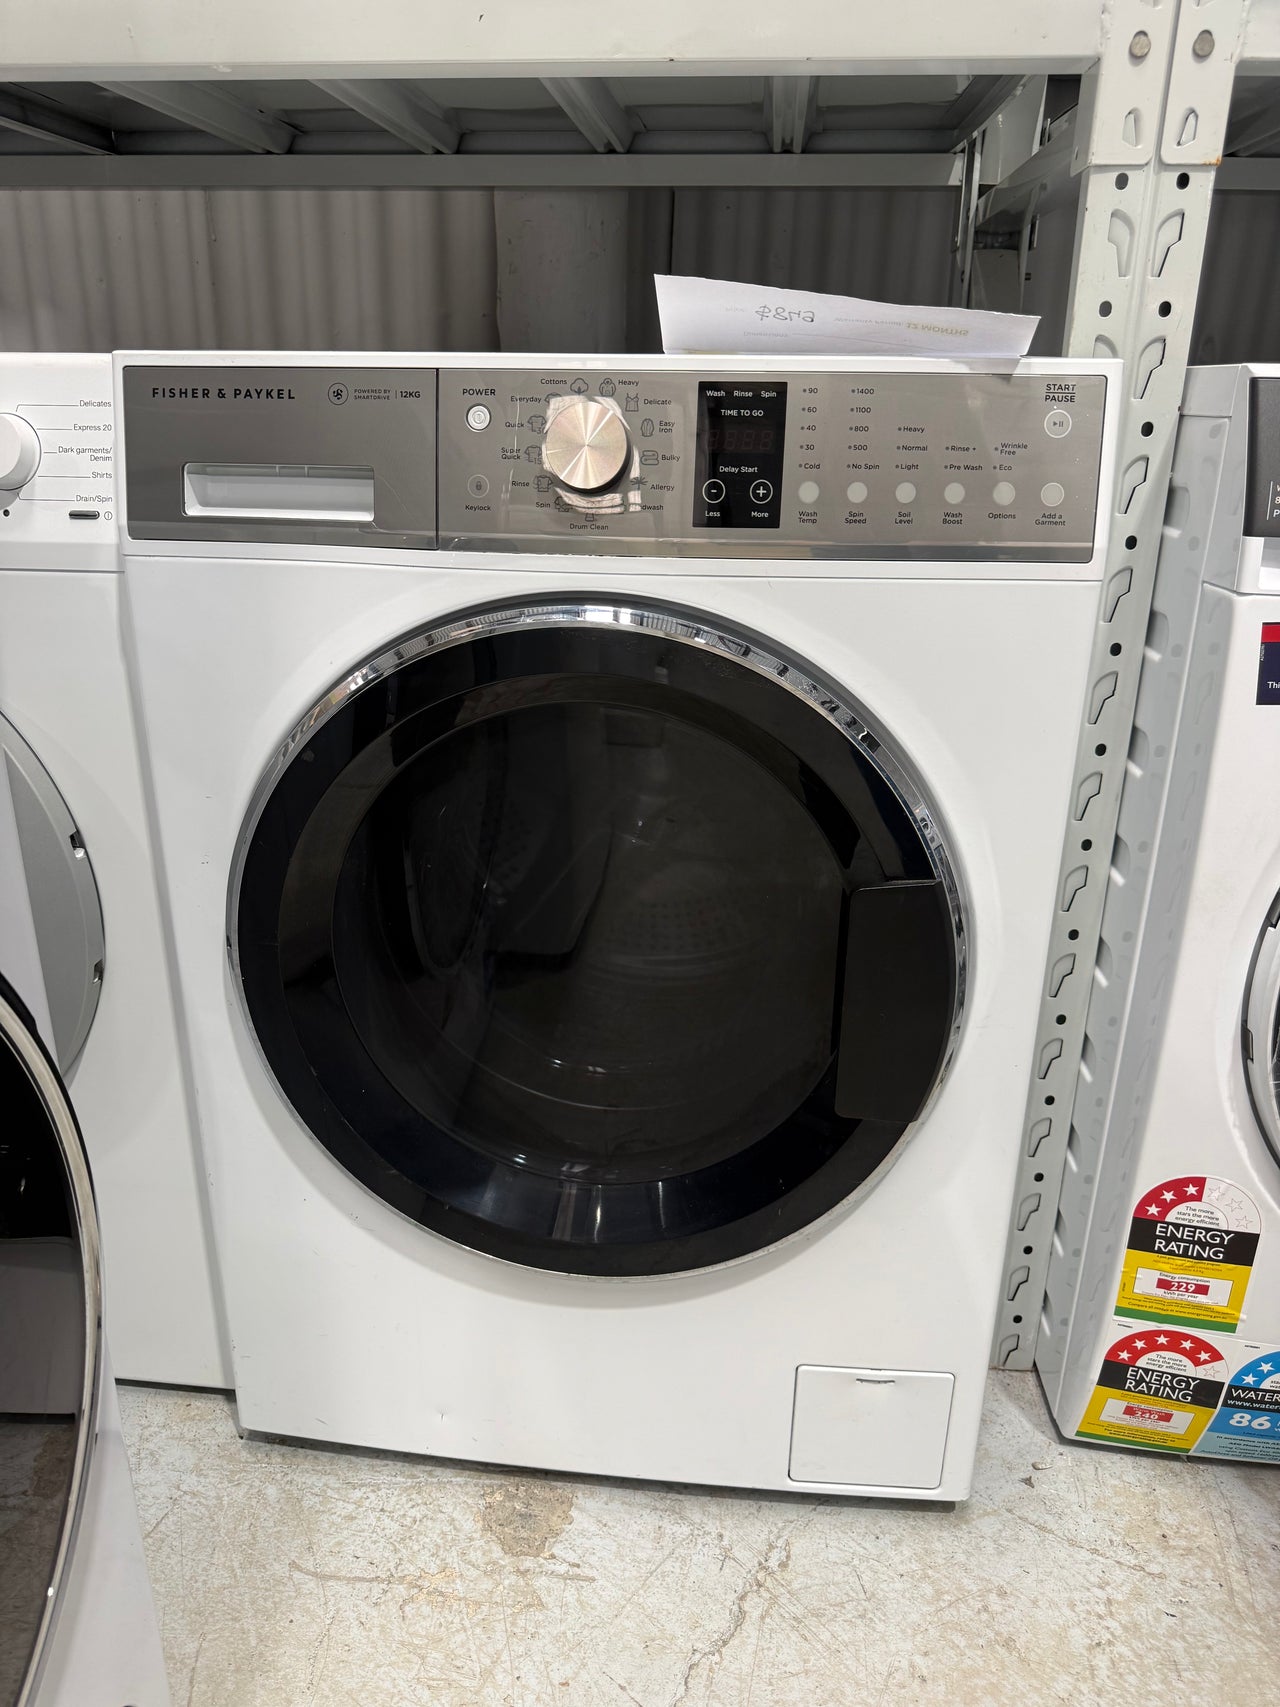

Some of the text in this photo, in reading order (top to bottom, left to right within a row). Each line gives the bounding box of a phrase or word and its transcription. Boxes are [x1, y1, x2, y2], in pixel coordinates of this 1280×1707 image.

[617, 379, 639, 387] Heavy
[462, 388, 496, 396] POWER
[1046, 384, 1077, 392] START
[152, 387, 296, 400] FISHER & PAYKEL
[400, 390, 421, 399] 12KG
[760, 390, 777, 398] Spin
[79, 399, 112, 408] Delicates
[510, 395, 542, 404] Everyday
[643, 398, 672, 406] Delicate
[1044, 395, 1076, 403] PAUSE
[73, 423, 112, 432] Express 20
[659, 420, 675, 429] Easy
[903, 426, 925, 434] Heavy
[58, 445, 112, 456] Dark garments/
[1000, 442, 1028, 450] Wrinkle
[661, 454, 680, 463] Bulky
[719, 465, 739, 474] Delay
[864, 463, 880, 471] Spin
[900, 463, 919, 471] Light
[91, 471, 112, 479] Shirts
[511, 480, 530, 488] Rinse
[650, 484, 675, 493] Allergy
[75, 494, 113, 504] Drain/Spin
[465, 504, 491, 512] Keylock
[535, 501, 551, 510] Spin
[798, 510, 818, 518] Wash
[848, 511, 864, 519] Spin
[988, 512, 1017, 520] Options
[1040, 512, 1056, 520] Add
[569, 523, 589, 531] Drum
[1196, 1218, 1220, 1226] efficient
[1155, 1224, 1235, 1245] ENERGY
[1154, 1238, 1225, 1260] RATING
[1160, 1272, 1211, 1284] Energy consumption
[1170, 1282, 1196, 1292] 229
[1165, 1364, 1187, 1372] efficient
[1126, 1368, 1200, 1390] ENERGY
[1124, 1379, 1193, 1402] RATING
[1232, 1388, 1280, 1402] WATER
[1227, 1400, 1280, 1410] www.water
[1229, 1412, 1272, 1430] 86
